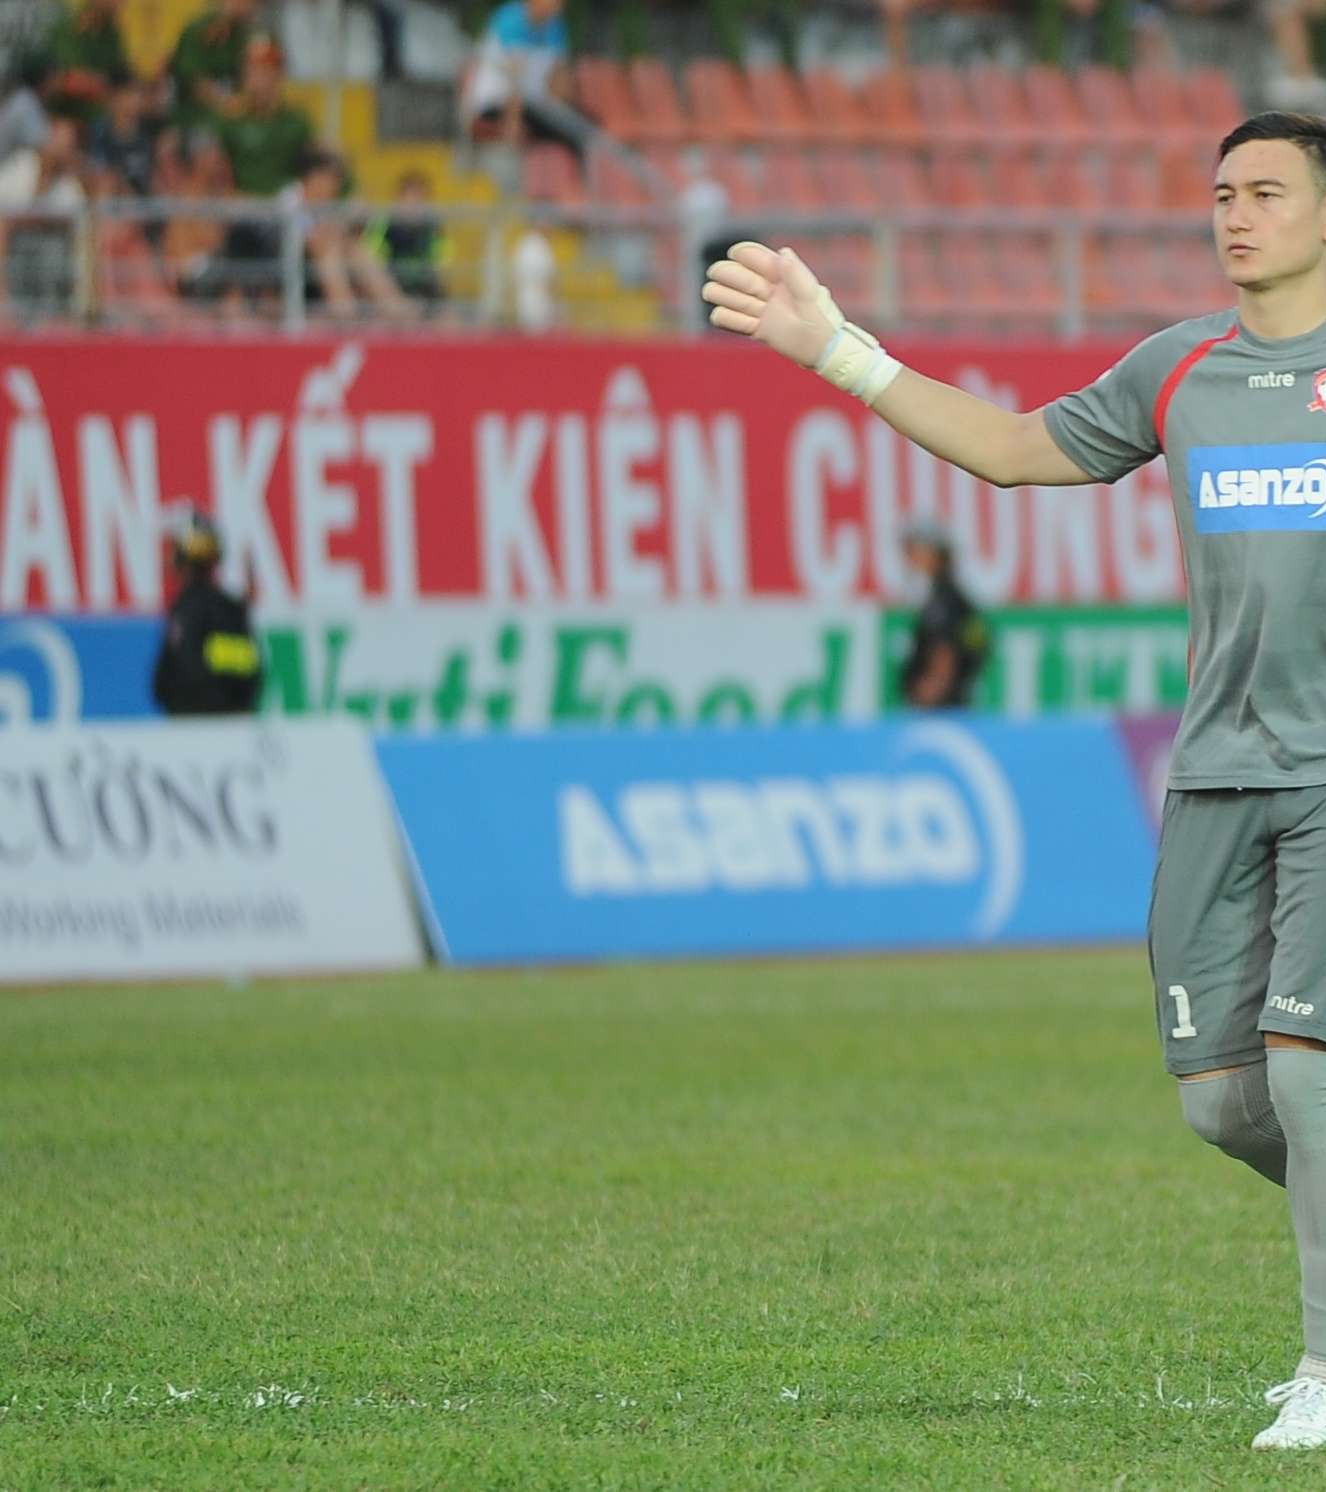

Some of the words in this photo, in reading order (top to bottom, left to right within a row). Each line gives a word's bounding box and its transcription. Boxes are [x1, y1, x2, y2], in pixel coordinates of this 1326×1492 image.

[1248, 370, 1296, 390] mitre
[210, 343, 434, 610] KẾT
[476, 364, 750, 608] KIÊN
[1168, 984, 1198, 1039] 1
